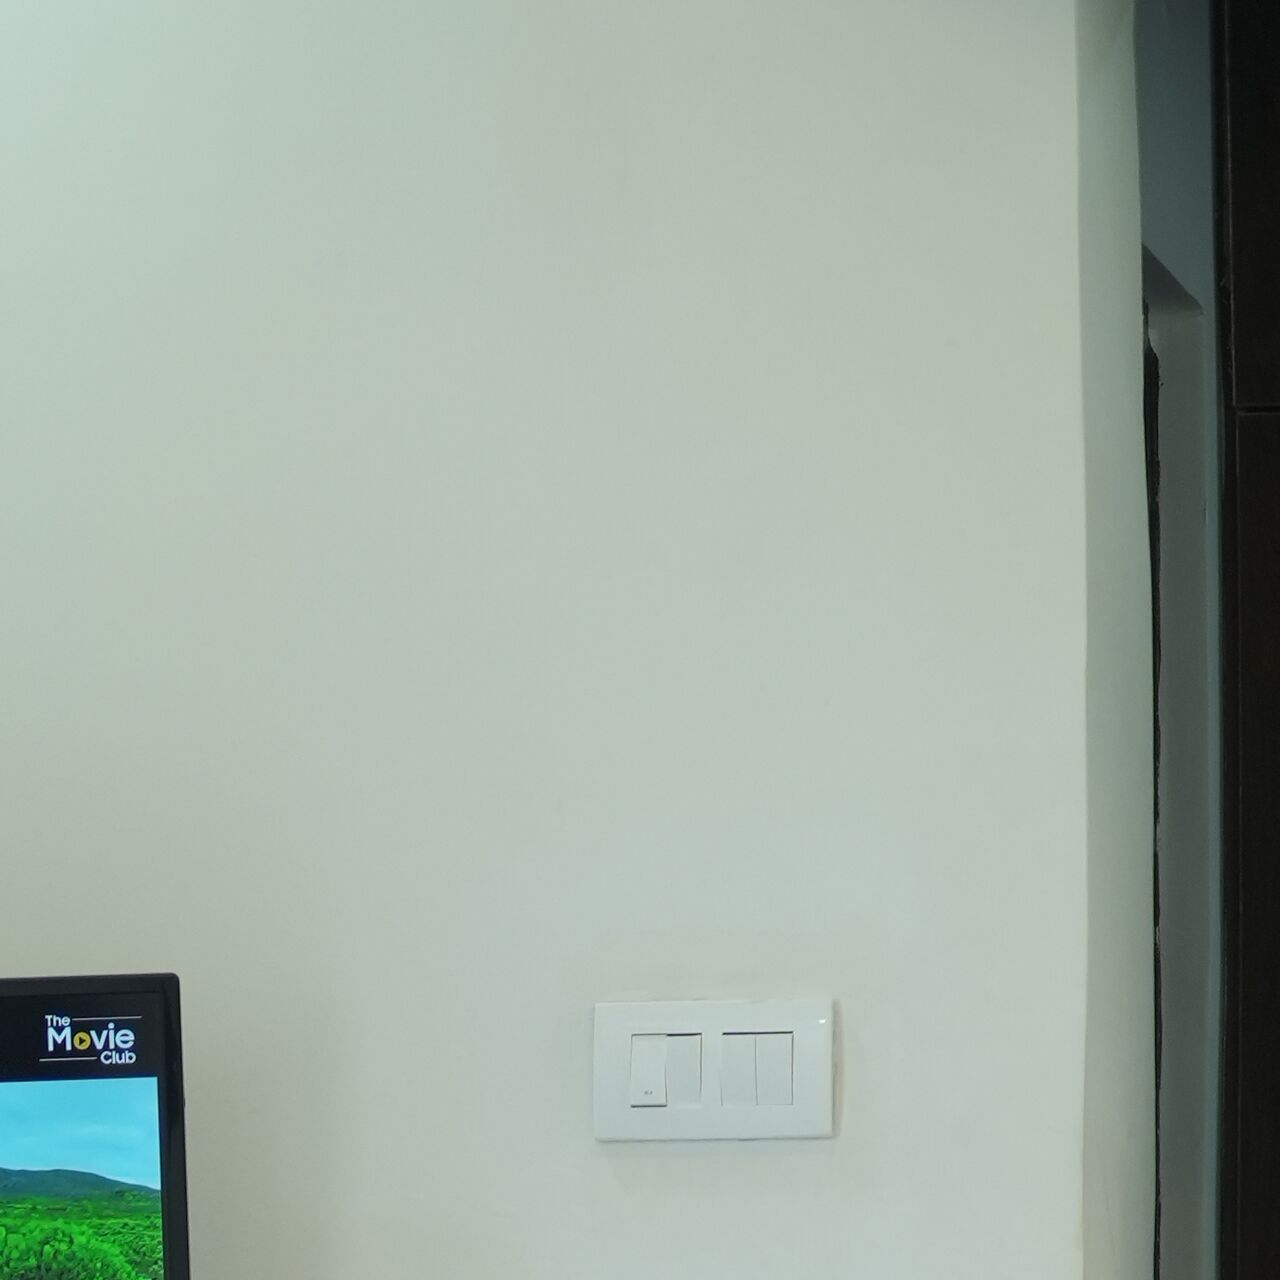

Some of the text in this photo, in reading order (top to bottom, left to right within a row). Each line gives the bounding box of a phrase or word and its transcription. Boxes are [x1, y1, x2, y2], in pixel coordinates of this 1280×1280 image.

[45, 1014, 70, 1027] The
[47, 1022, 135, 1052] Movie
[100, 1050, 136, 1065] Club
